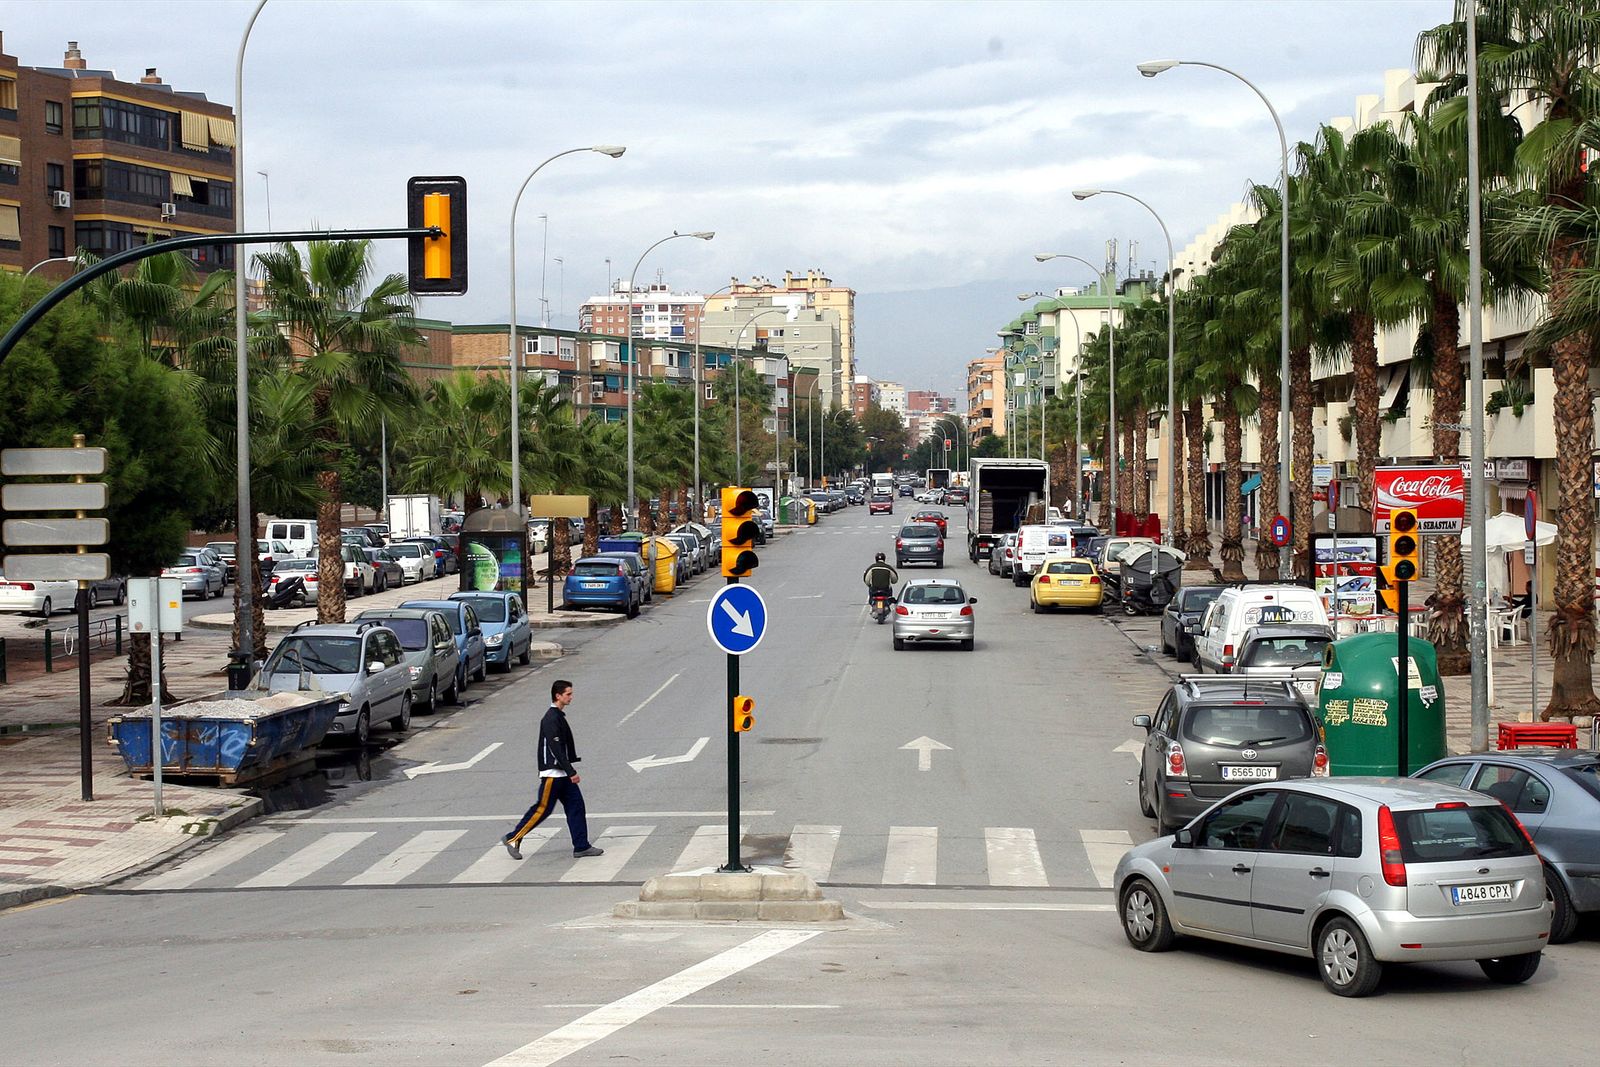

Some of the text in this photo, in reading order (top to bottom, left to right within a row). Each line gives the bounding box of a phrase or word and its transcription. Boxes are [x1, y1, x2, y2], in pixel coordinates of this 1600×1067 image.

[1389, 475, 1453, 497] Coca-Cola
[1423, 520, 1457, 530] SEBASTIAN
[1231, 767, 1272, 777] 6565 DGY
[1460, 885, 1510, 900] 4848 CPX
